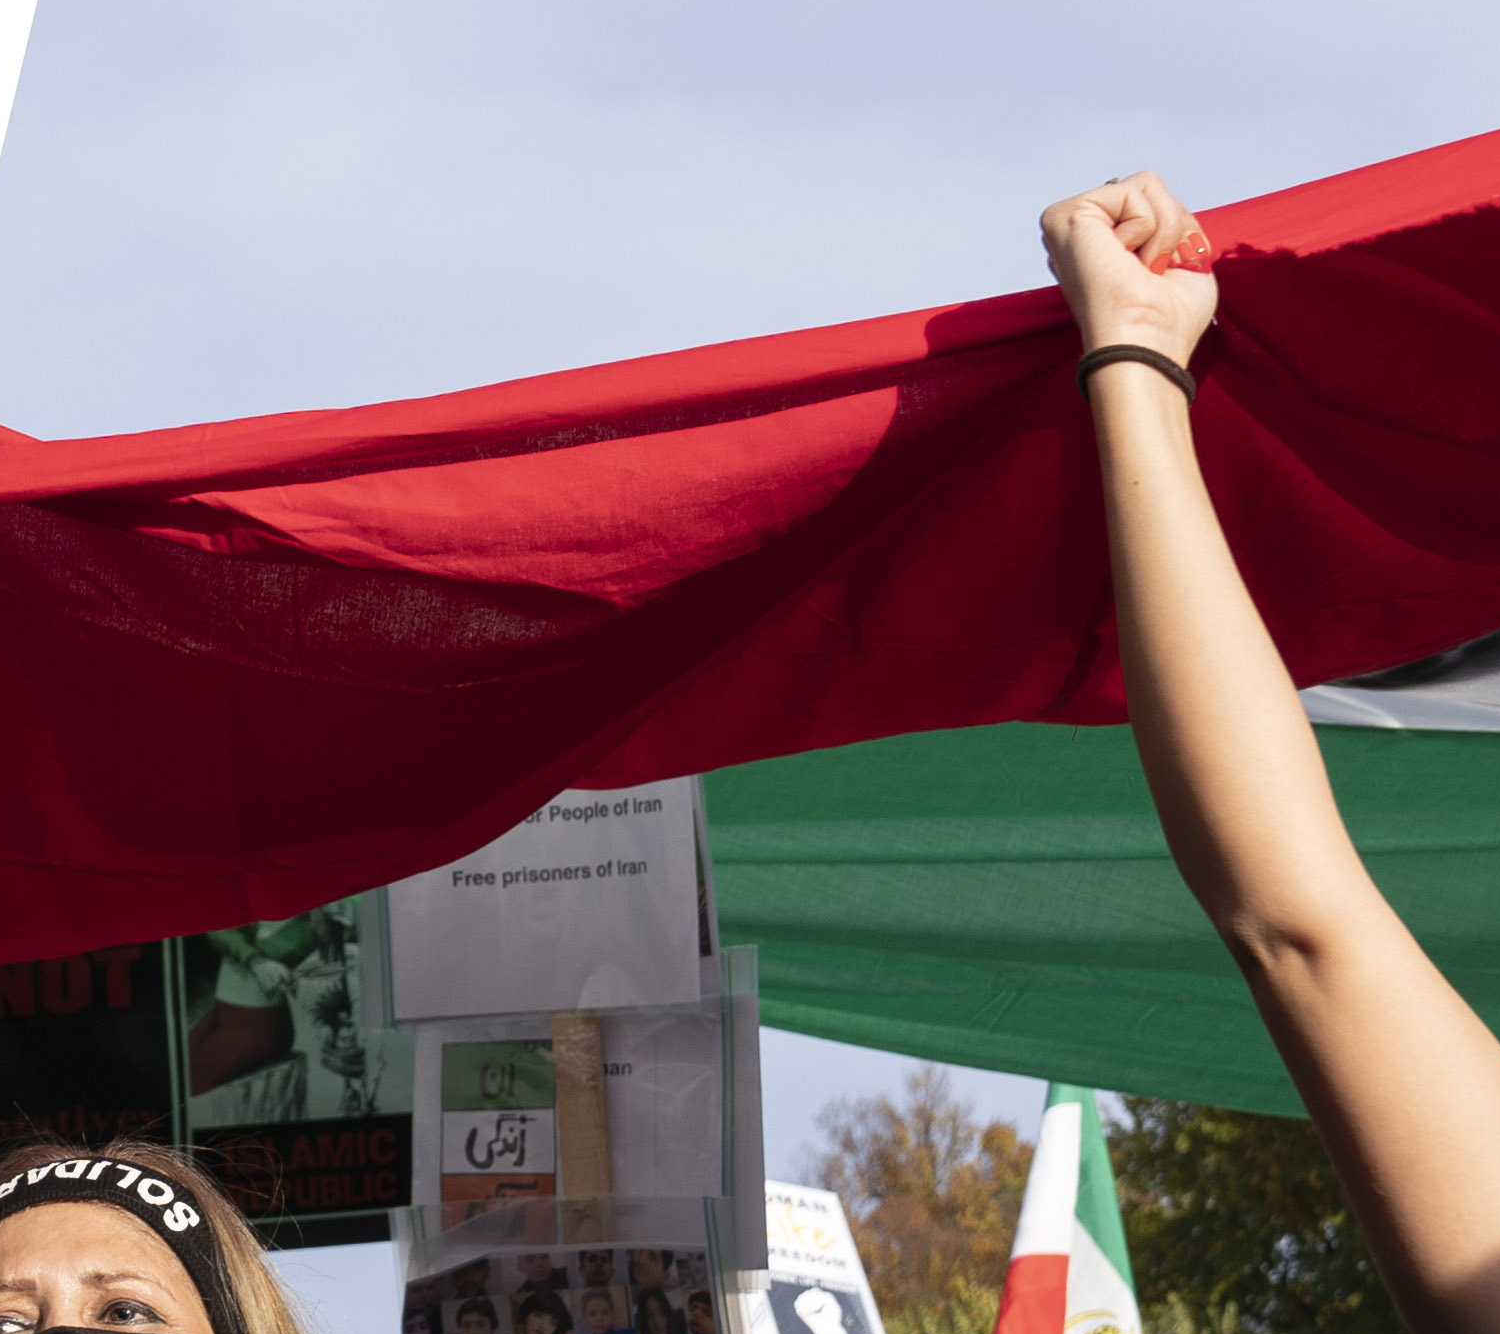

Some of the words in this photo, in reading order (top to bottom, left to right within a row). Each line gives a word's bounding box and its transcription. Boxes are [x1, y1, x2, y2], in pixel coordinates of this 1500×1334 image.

[549, 801, 609, 824] People
[613, 798, 630, 817] of
[633, 797, 663, 814] Iran
[452, 869, 496, 887] Free
[503, 865, 592, 889] prisoners
[596, 858, 613, 877] of
[616, 858, 648, 876] Iran
[223, 1128, 398, 1176] ISLAMIC
[465, 1113, 537, 1170] زندگی
[224, 1169, 398, 1212] REPUBLIC
